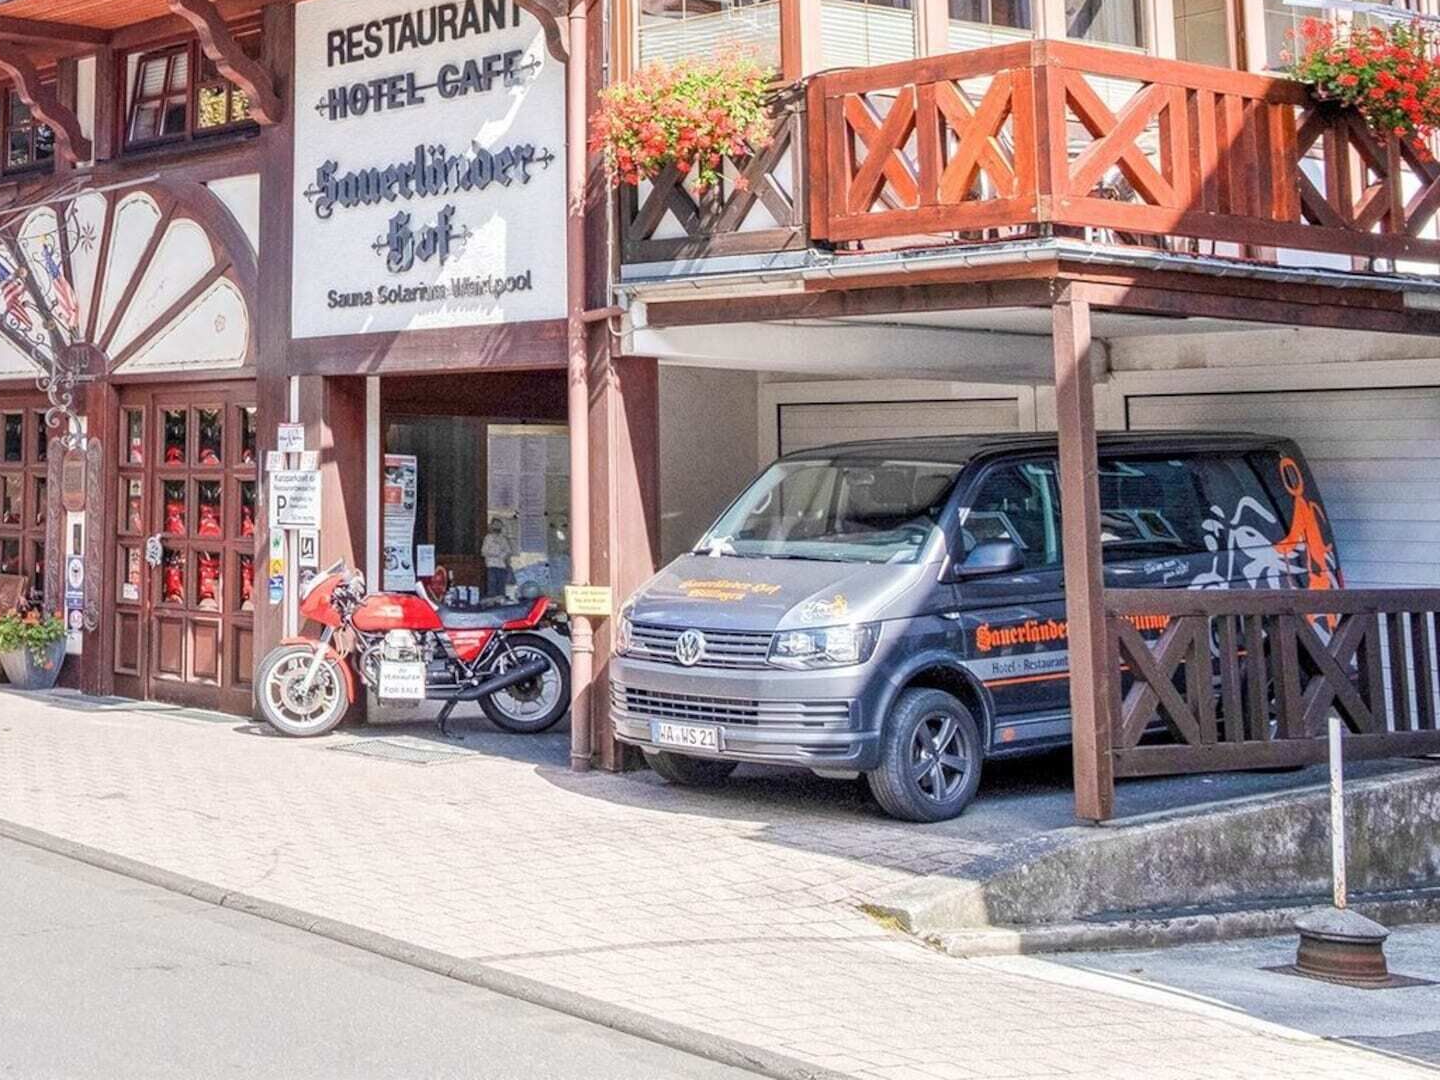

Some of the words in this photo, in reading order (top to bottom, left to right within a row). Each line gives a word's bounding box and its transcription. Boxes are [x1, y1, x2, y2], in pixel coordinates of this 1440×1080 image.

[328, 72, 424, 120] HOTEL
[316, 140, 536, 219] Sauerländer
[386, 204, 456, 273] Hof
[327, 289, 373, 309] Sauna
[377, 282, 447, 305] Solarium
[450, 270, 533, 299] Whirlpool
[277, 495, 287, 517] P
[992, 661, 1016, 674] Hotel
[700, 730, 716, 746] 21
